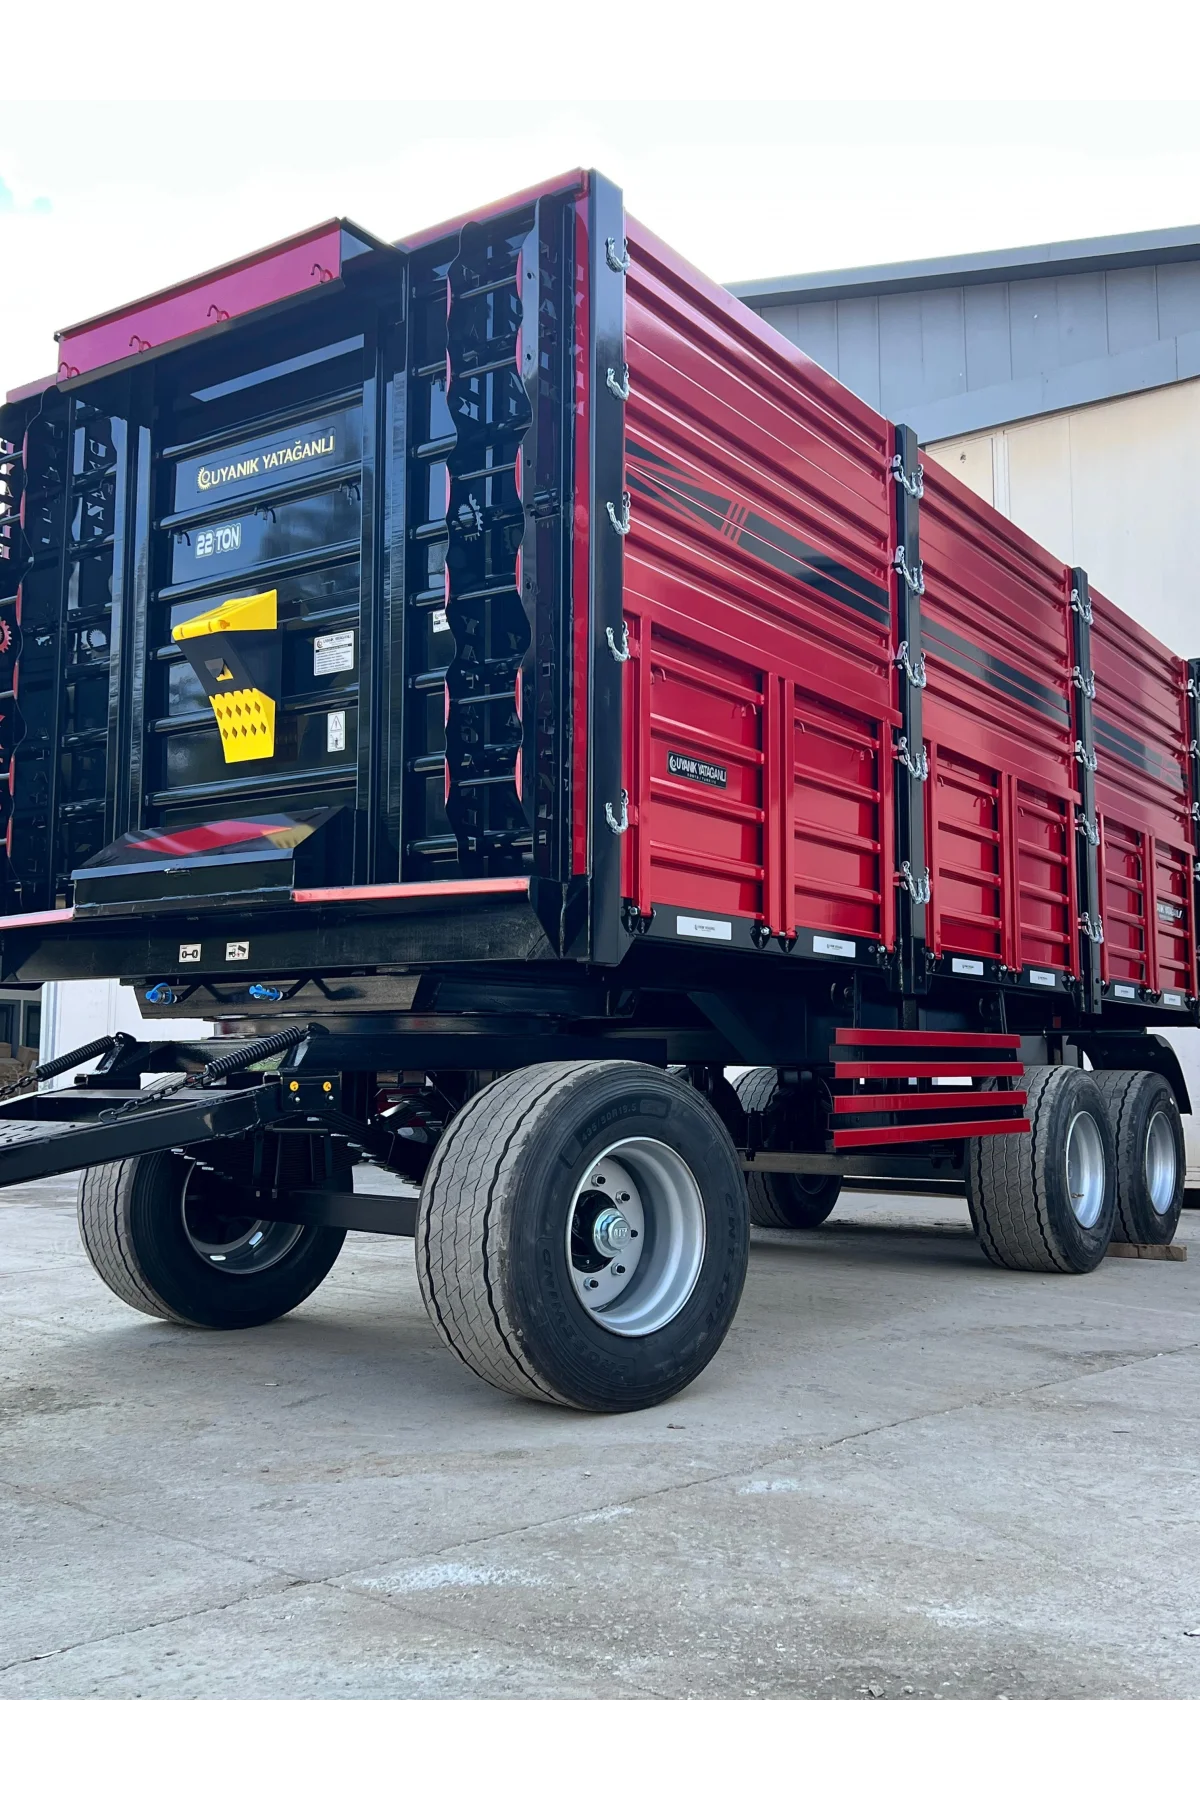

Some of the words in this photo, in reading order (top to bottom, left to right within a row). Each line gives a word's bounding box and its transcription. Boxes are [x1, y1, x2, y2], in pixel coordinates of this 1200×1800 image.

[211, 458, 259, 485] UYANIK
[196, 532, 213, 556] 22
[215, 525, 240, 551] TON
